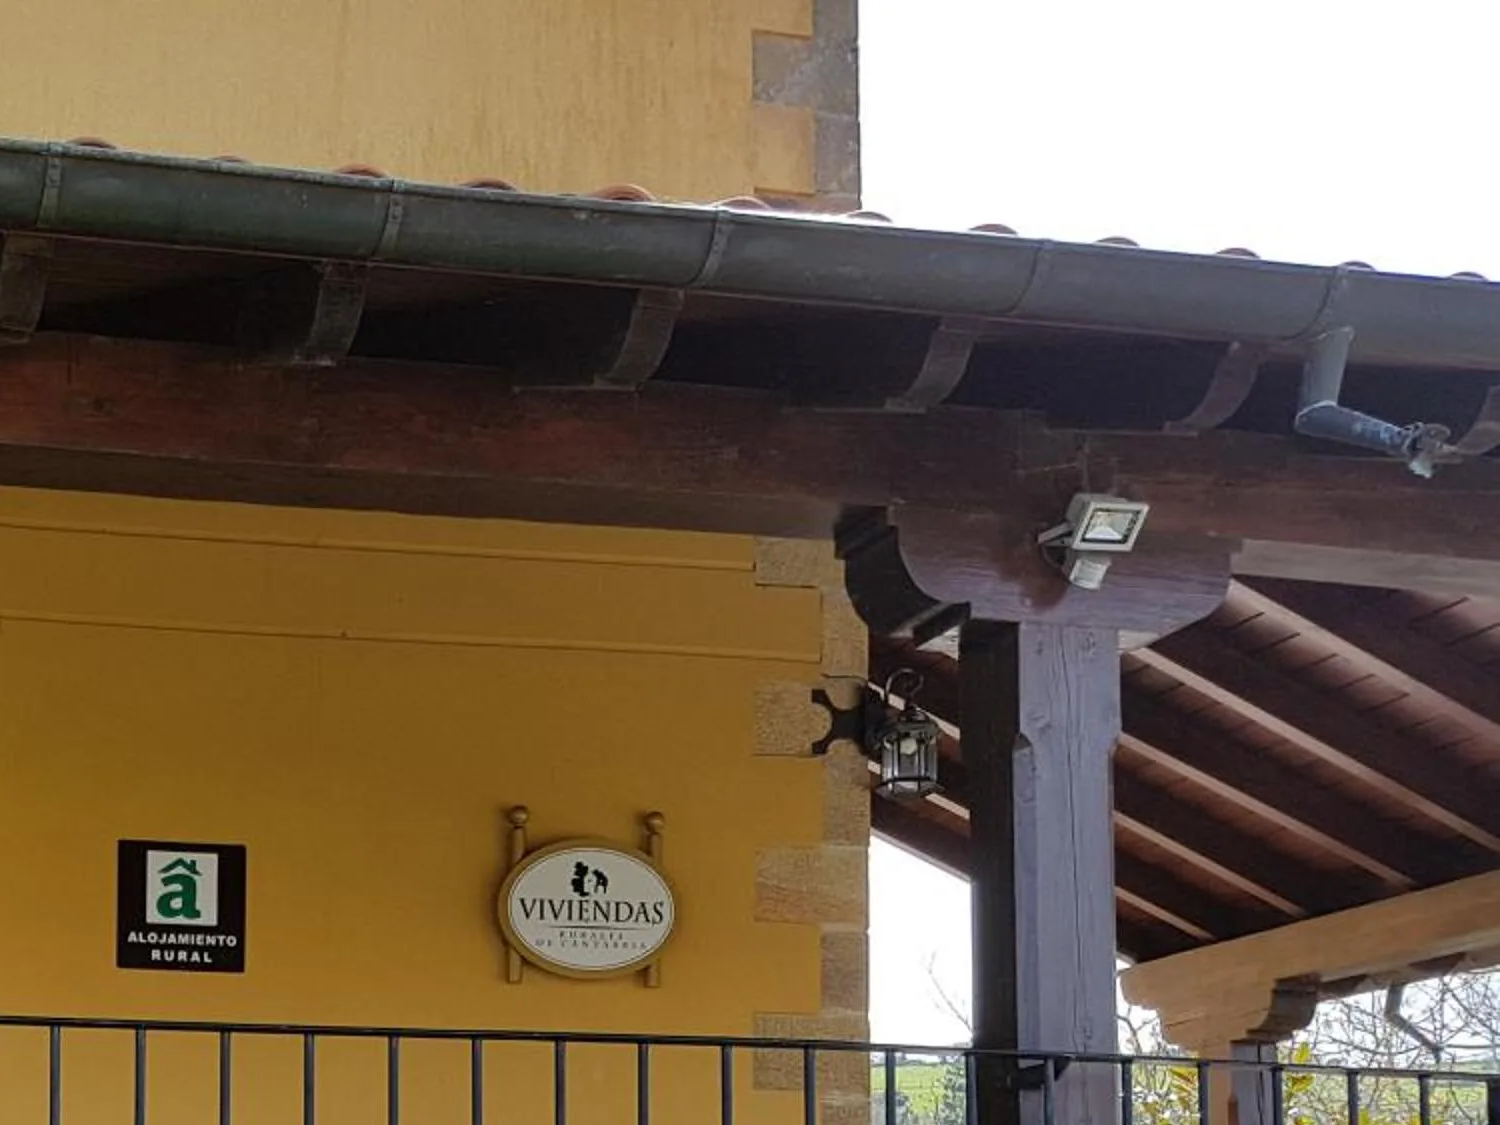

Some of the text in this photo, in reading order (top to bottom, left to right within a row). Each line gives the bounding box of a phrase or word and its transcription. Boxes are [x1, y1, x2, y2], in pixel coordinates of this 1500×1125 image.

[518, 897, 666, 926] VIVIENDAS
[127, 931, 238, 947] ALOJAMIENTO
[151, 948, 213, 964] RURAL
